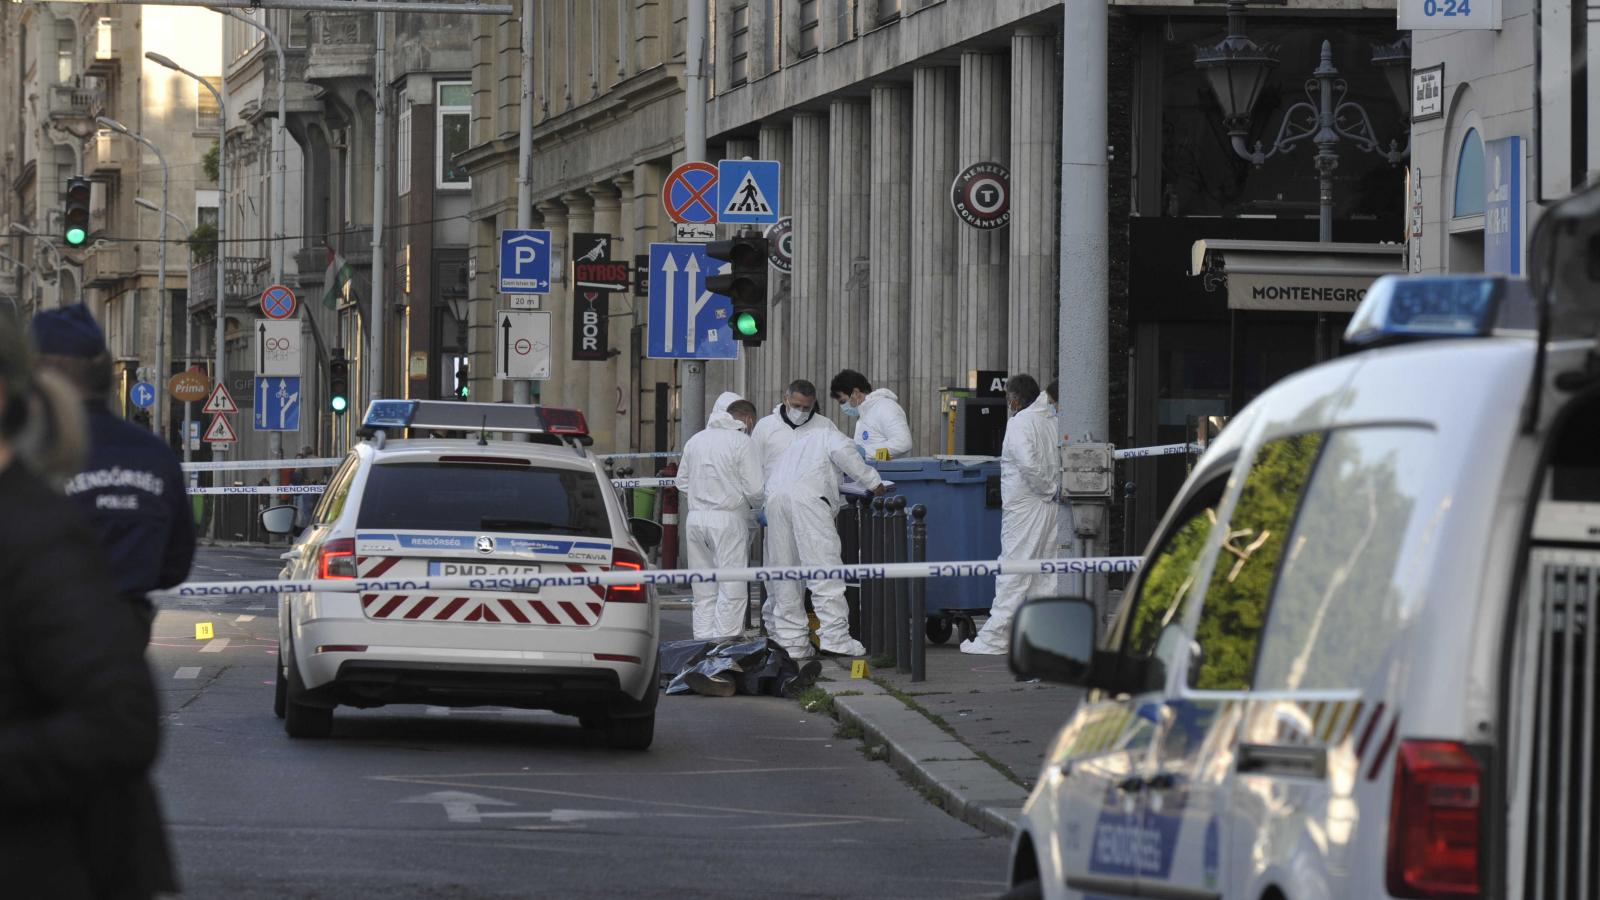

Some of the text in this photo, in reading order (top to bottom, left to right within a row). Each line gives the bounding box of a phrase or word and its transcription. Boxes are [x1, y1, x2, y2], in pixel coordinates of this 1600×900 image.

[1423, 0, 1471, 17] 0-24
[963, 165, 1010, 182] NEMZETI
[981, 190, 994, 203] T
[515, 246, 536, 275] P
[577, 264, 626, 281] GYROS
[515, 297, 525, 305] 20
[1252, 286, 1367, 302] MONTENEGRO
[583, 311, 598, 350] BOR
[174, 383, 205, 394] Prima
[990, 377, 1008, 392] AT
[613, 480, 640, 488] OLICE
[567, 552, 607, 561] OCTAVIA
